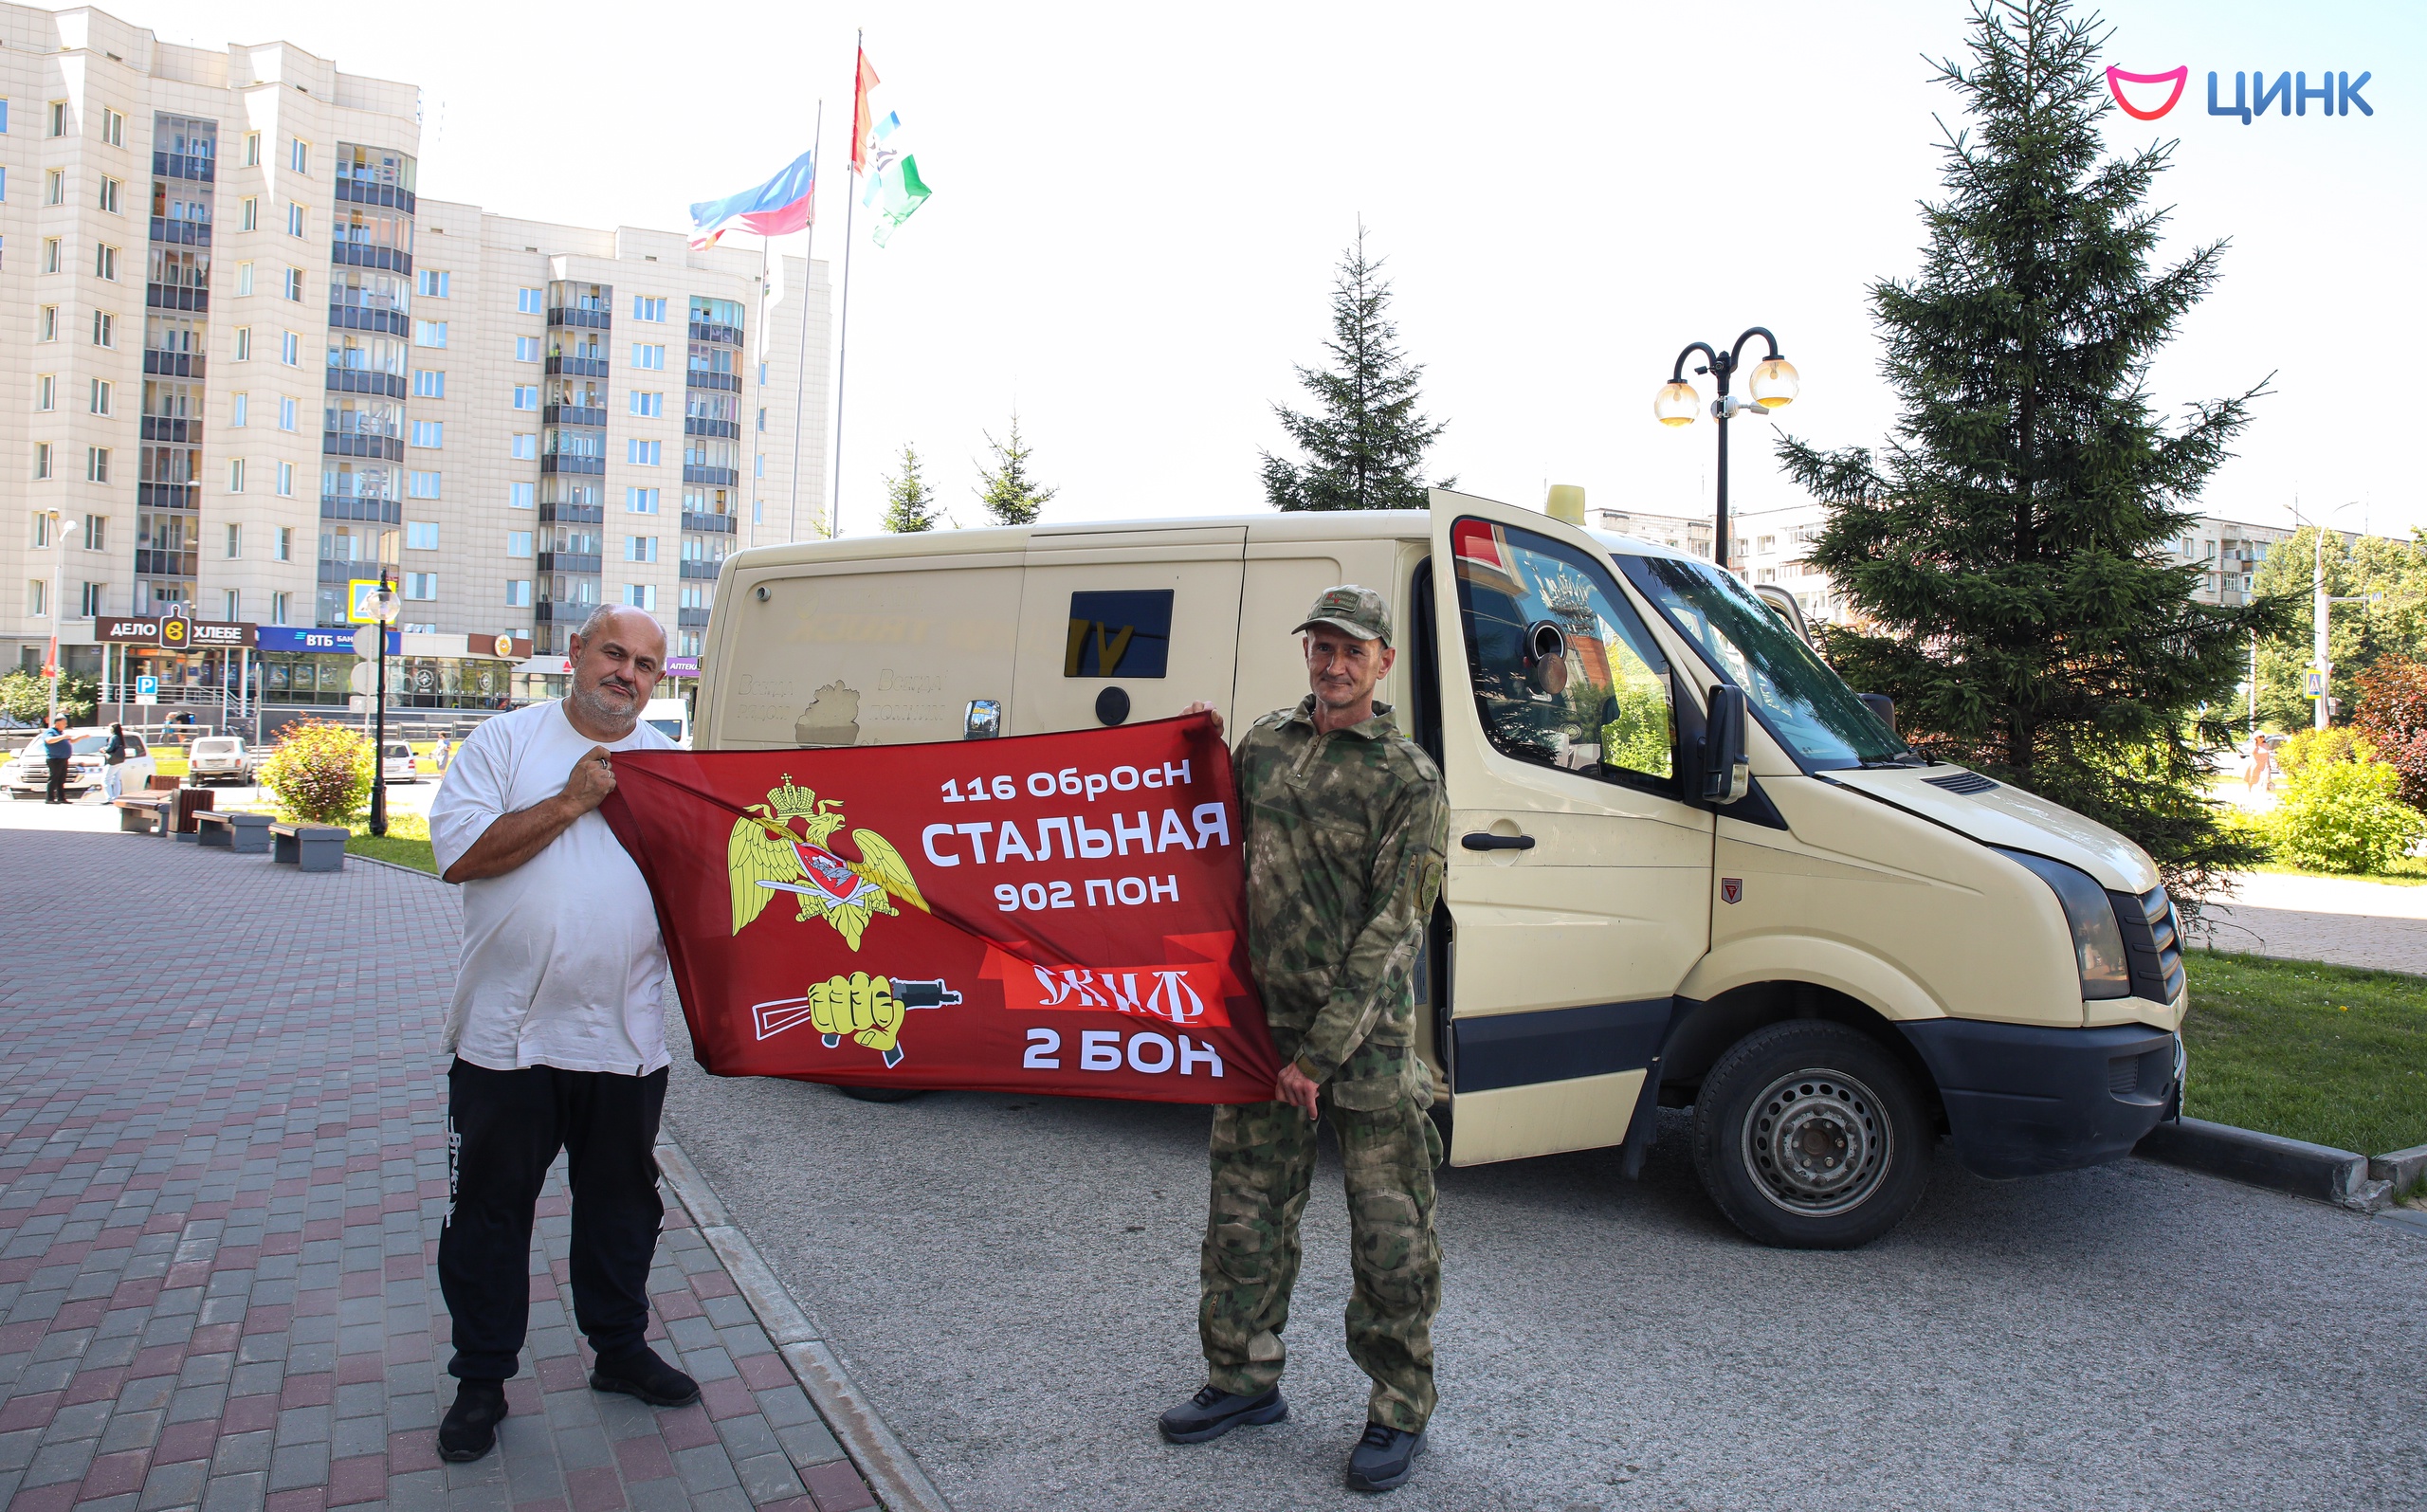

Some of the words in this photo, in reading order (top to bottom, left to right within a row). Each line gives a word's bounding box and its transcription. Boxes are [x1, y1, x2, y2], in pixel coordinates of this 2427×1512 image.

[110, 623, 157, 637] ДЕЛО
[193, 626, 243, 640] ХЛЕБЕ
[306, 634, 334, 647] ВТБ
[141, 679, 154, 692] P
[940, 774, 1017, 803] 116
[1026, 758, 1193, 802] ОбрОсН
[922, 802, 1231, 867] СТАЛЬНАЯ
[994, 881, 1076, 912] 902
[1084, 874, 1179, 907] ПОН
[1023, 1028, 1061, 1070] 2
[1080, 1030, 1224, 1078] БОН
